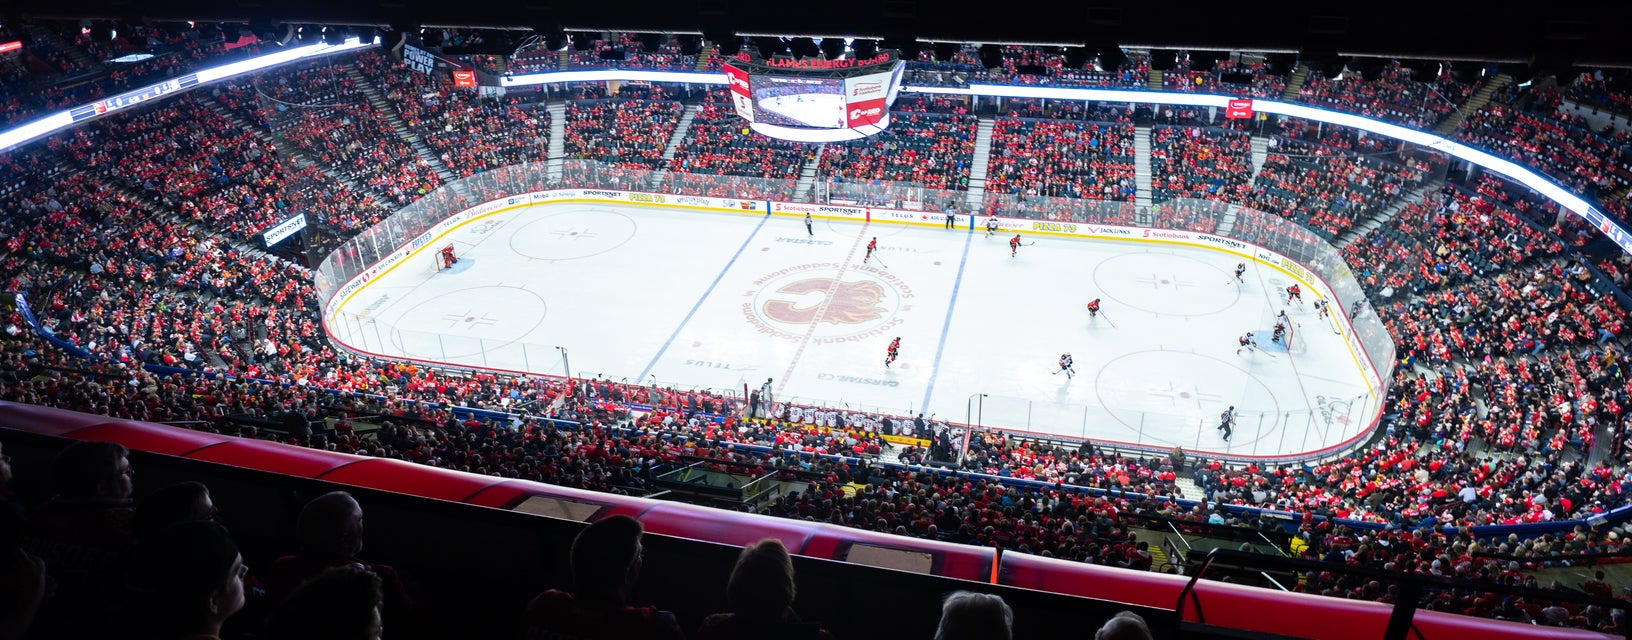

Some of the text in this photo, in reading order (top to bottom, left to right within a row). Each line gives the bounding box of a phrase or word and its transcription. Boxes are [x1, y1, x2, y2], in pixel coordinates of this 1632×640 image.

[404, 49, 434, 68] POWER
[404, 58, 433, 75] PLAY
[810, 58, 855, 69] ENERGY
[629, 193, 653, 202] PIZZA
[266, 217, 304, 240] SPORTSNET
[443, 217, 460, 228] TELUS
[1033, 222, 1076, 233] PIZZA 73
[1198, 235, 1246, 249] SPORTSNET
[1281, 259, 1305, 278] PIZZA
[340, 278, 361, 300] SAFEWAY
[851, 263, 915, 299] Scotiabank
[814, 316, 904, 345] Scotiabank
[685, 359, 730, 370] TELUS
